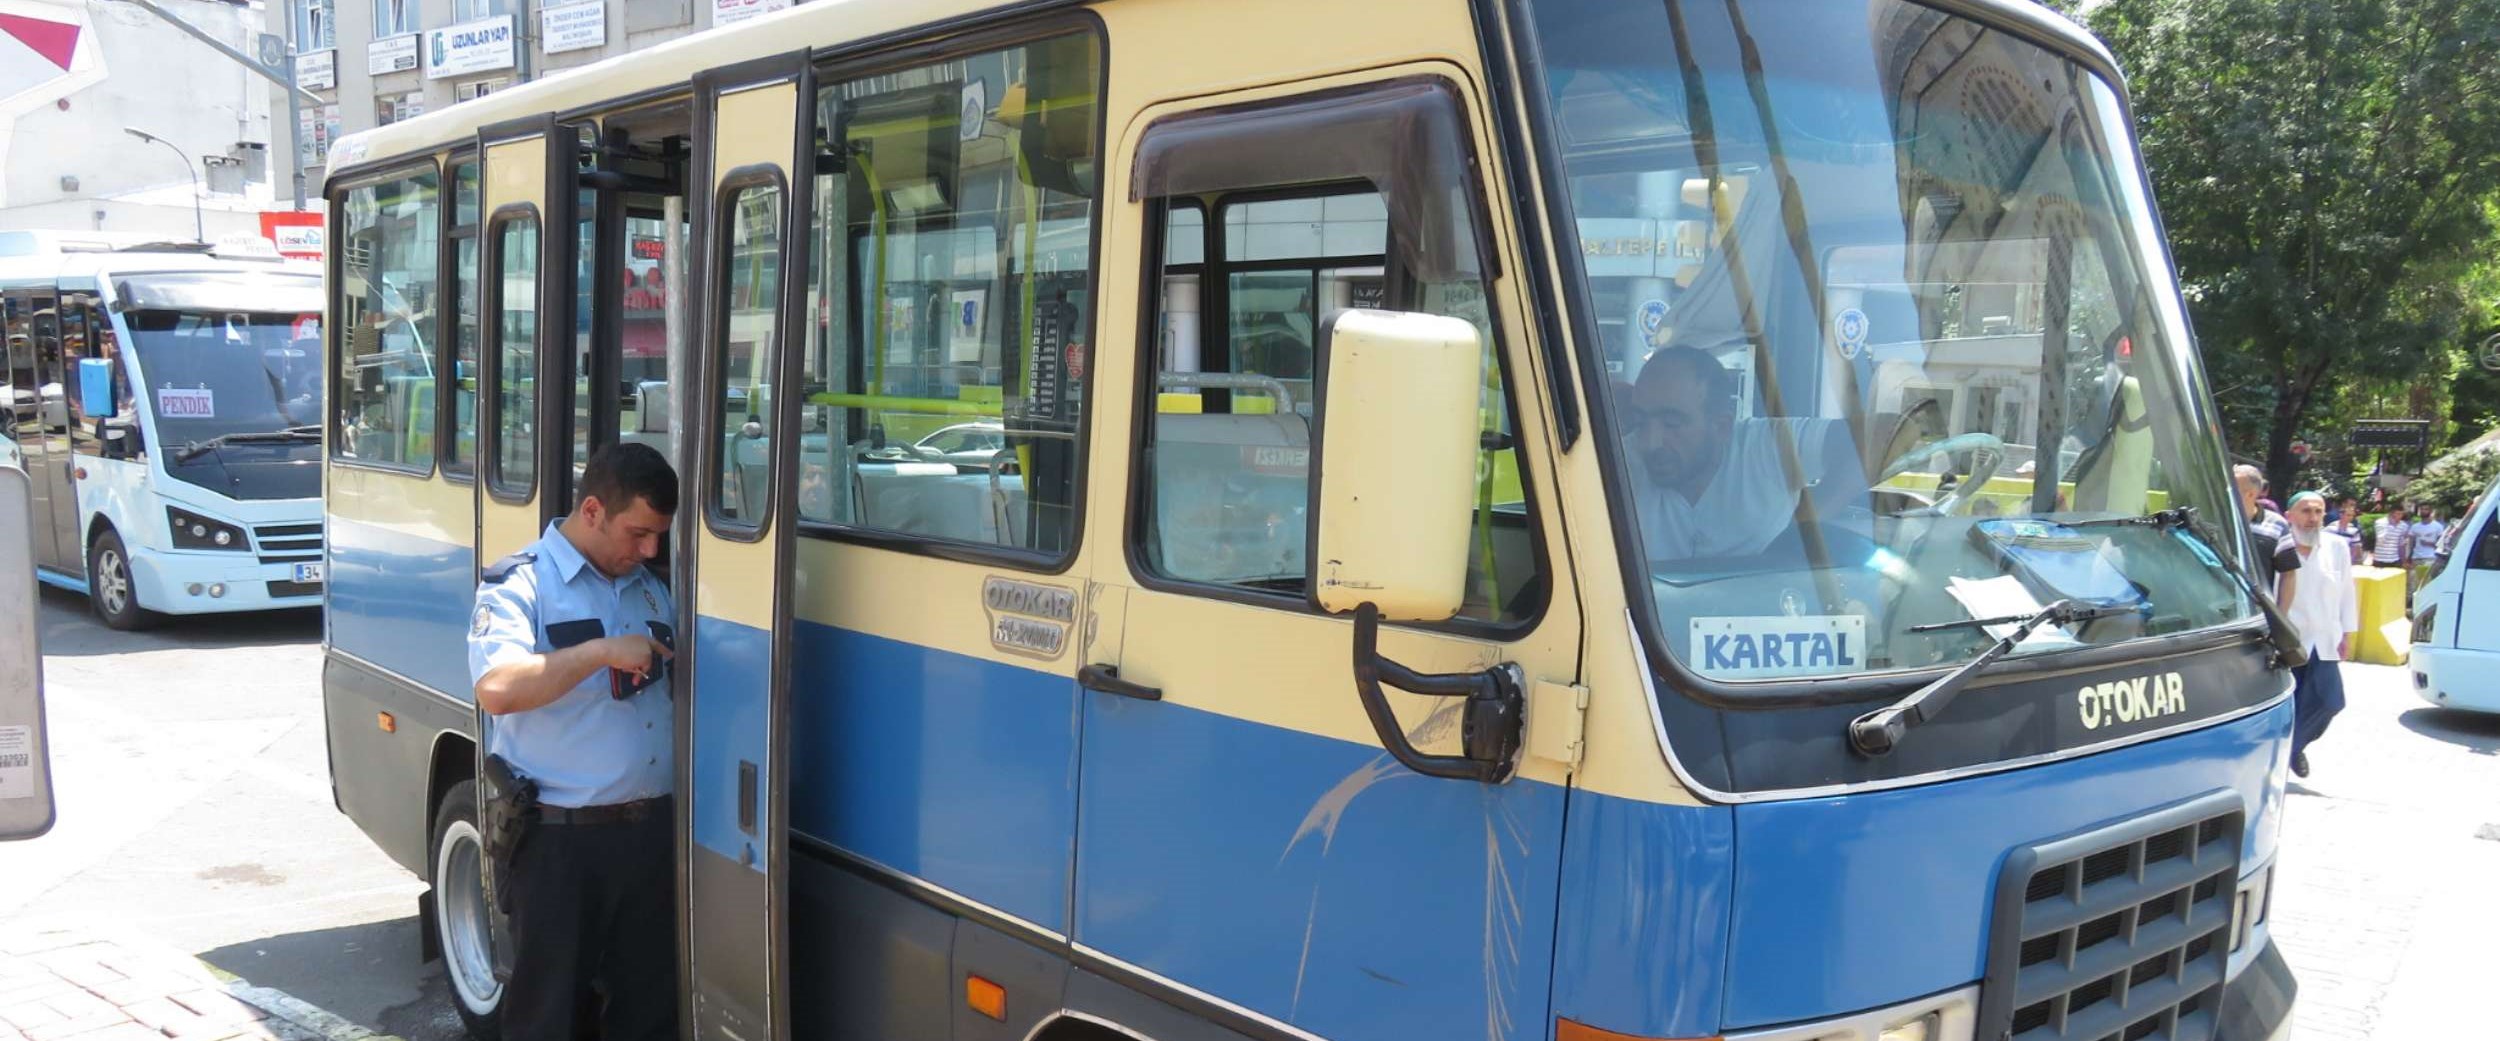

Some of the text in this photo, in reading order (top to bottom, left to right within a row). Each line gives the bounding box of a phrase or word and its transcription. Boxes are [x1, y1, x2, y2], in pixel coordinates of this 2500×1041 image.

[452, 25, 509, 49] UZUNLAR YAPI
[162, 391, 210, 414] PENDİK
[304, 565, 320, 579] 34
[986, 581, 1075, 620] OTOKAR
[1704, 632, 1854, 670] KARTAL
[2078, 672, 2186, 730] OTOKAR
